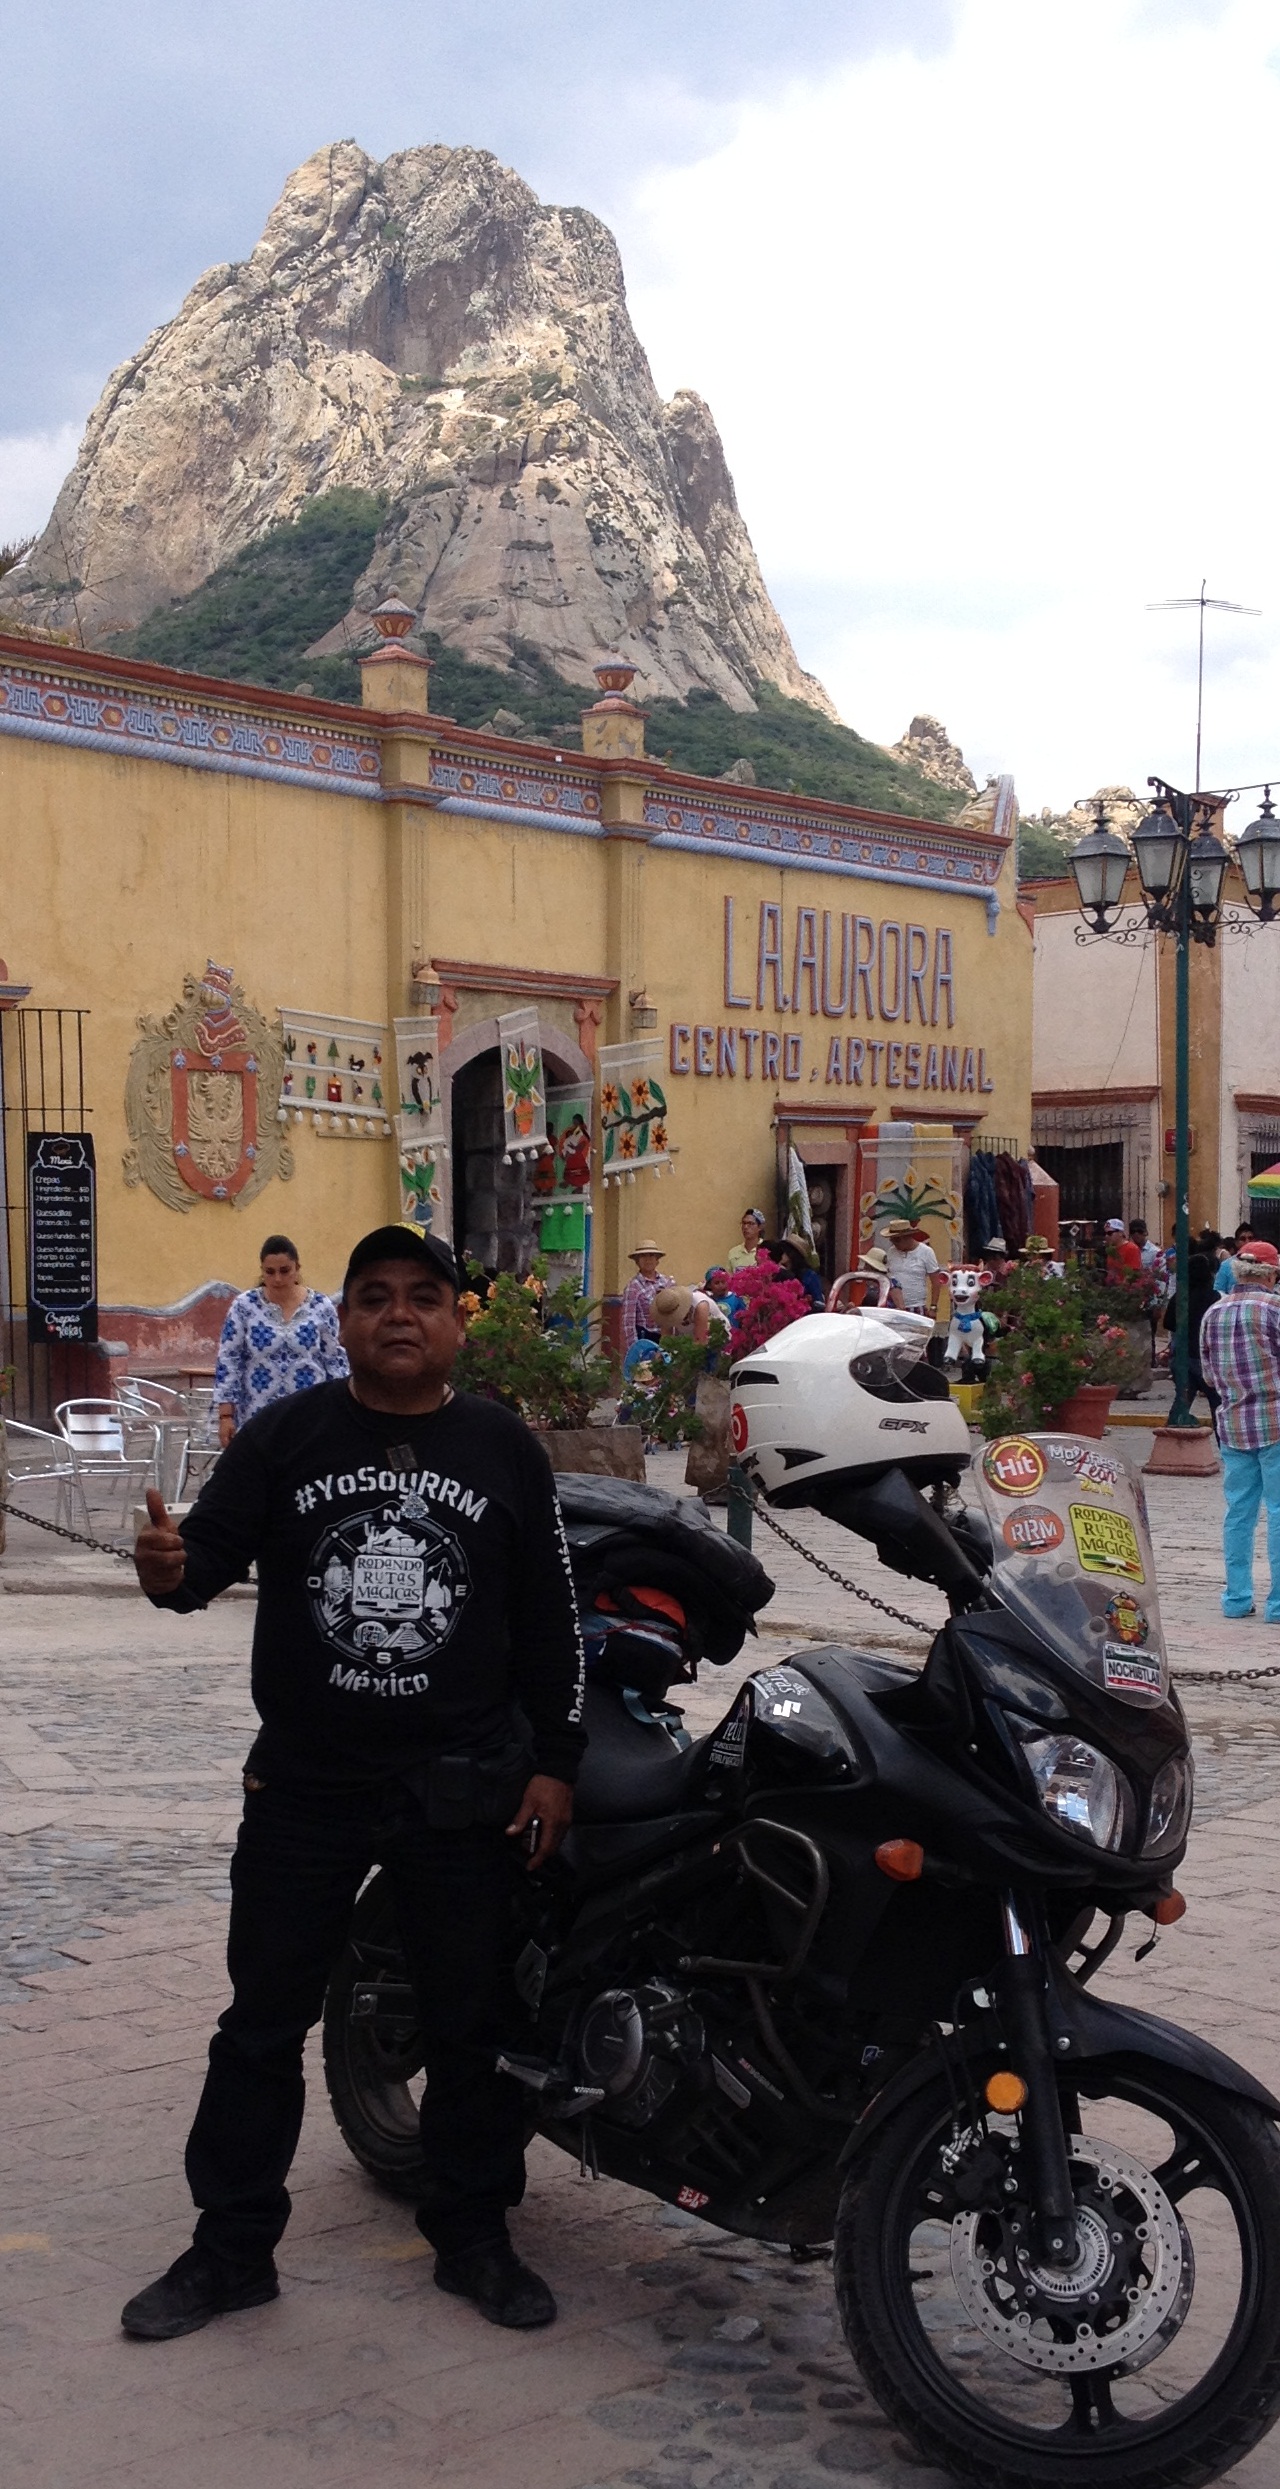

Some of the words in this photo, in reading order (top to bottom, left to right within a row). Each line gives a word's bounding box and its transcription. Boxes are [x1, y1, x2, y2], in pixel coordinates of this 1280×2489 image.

[724, 895, 783, 1013] LA
[792, 906, 955, 1028] AURORA
[670, 1023, 803, 1081] CENTRO
[826, 1036, 994, 1093] ARTESANAL
[879, 1417, 930, 1434] GPX
[995, 1455, 1037, 1479] Hit
[294, 1466, 489, 1523] #YoSoyRRM
[383, 1509, 401, 1521] N
[1010, 1519, 1057, 1541] RRM
[328, 1663, 429, 1697] México
